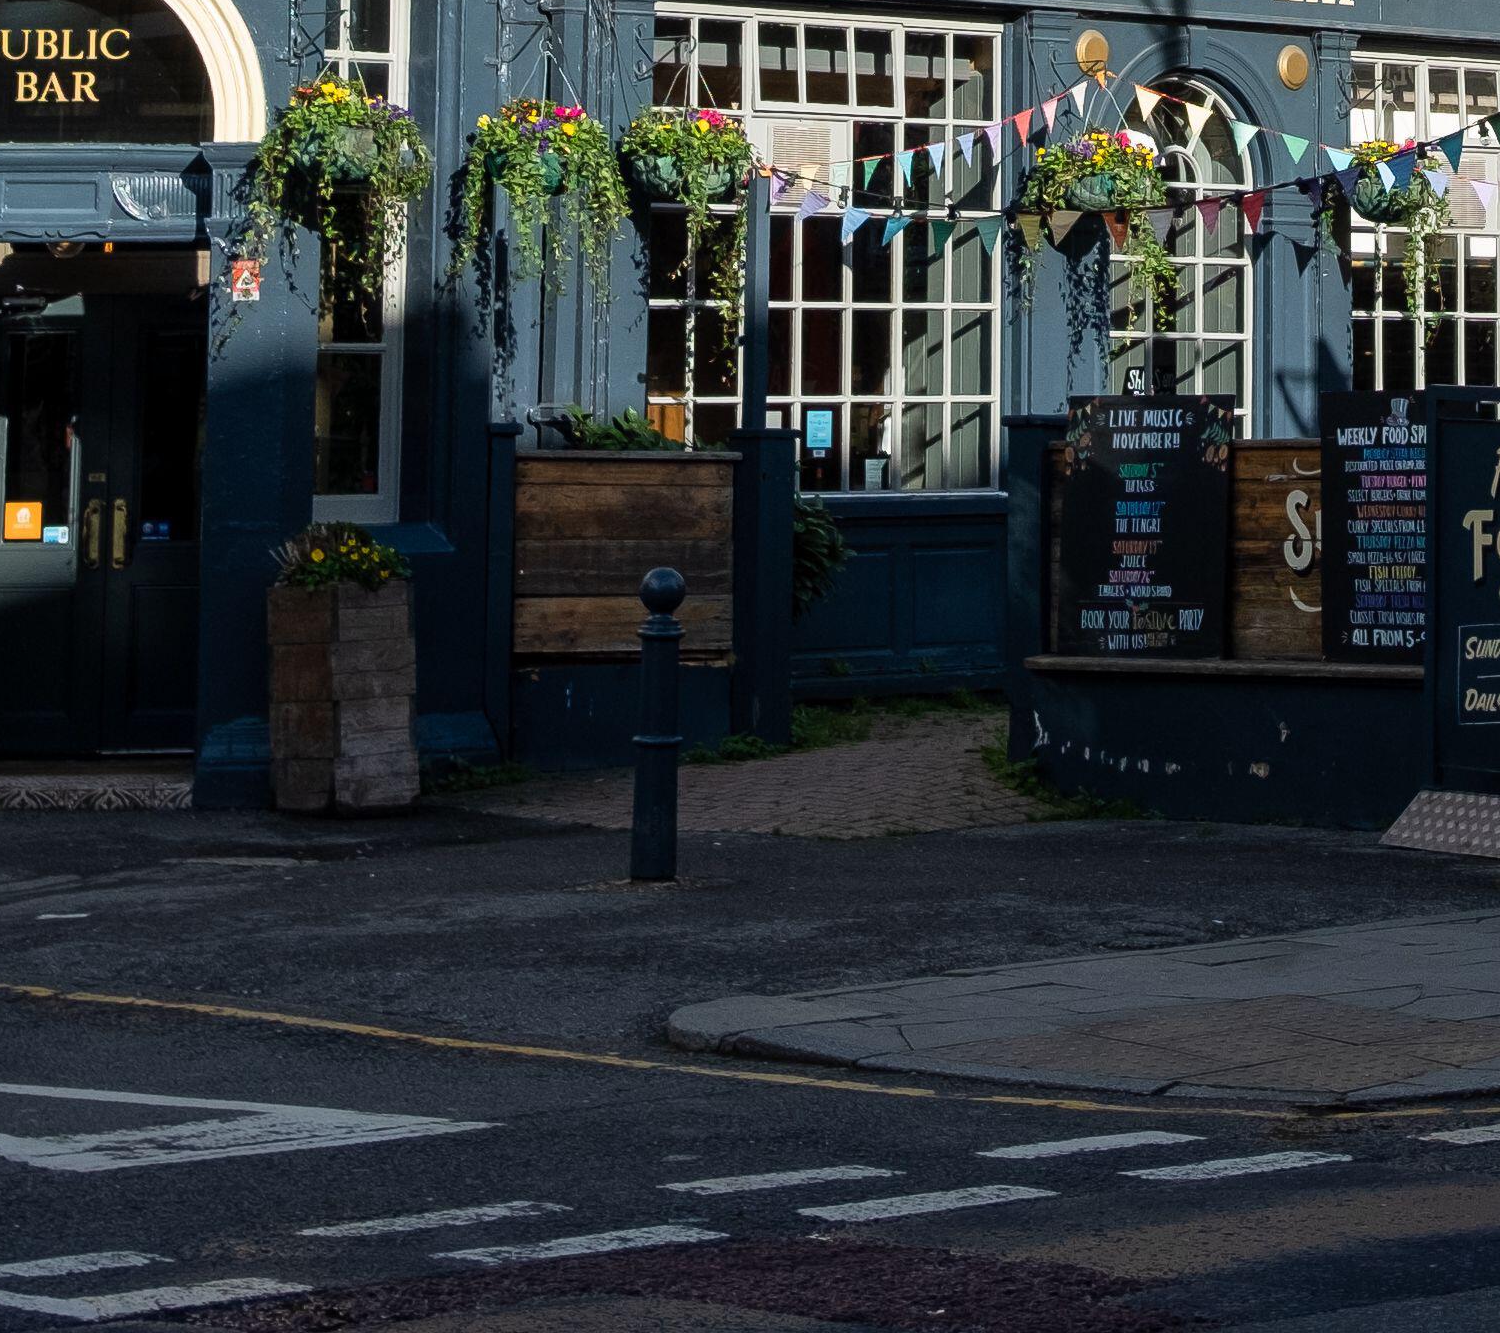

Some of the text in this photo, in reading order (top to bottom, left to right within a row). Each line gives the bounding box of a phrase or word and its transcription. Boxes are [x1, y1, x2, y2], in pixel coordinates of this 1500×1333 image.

[14, 69, 100, 104] BAR
[1109, 408, 1184, 428] LIVE MUSIC
[1336, 426, 1409, 445] WEEKLY FOOD
[1112, 540, 1148, 554] SATURDAY
[1120, 554, 1147, 568] JUICE
[1369, 565, 1389, 580] FISH
[1081, 608, 1205, 631] BOOK YOUR PARTY
[1108, 634, 1130, 650] WITH
[1352, 628, 1404, 647] ALL FROM
